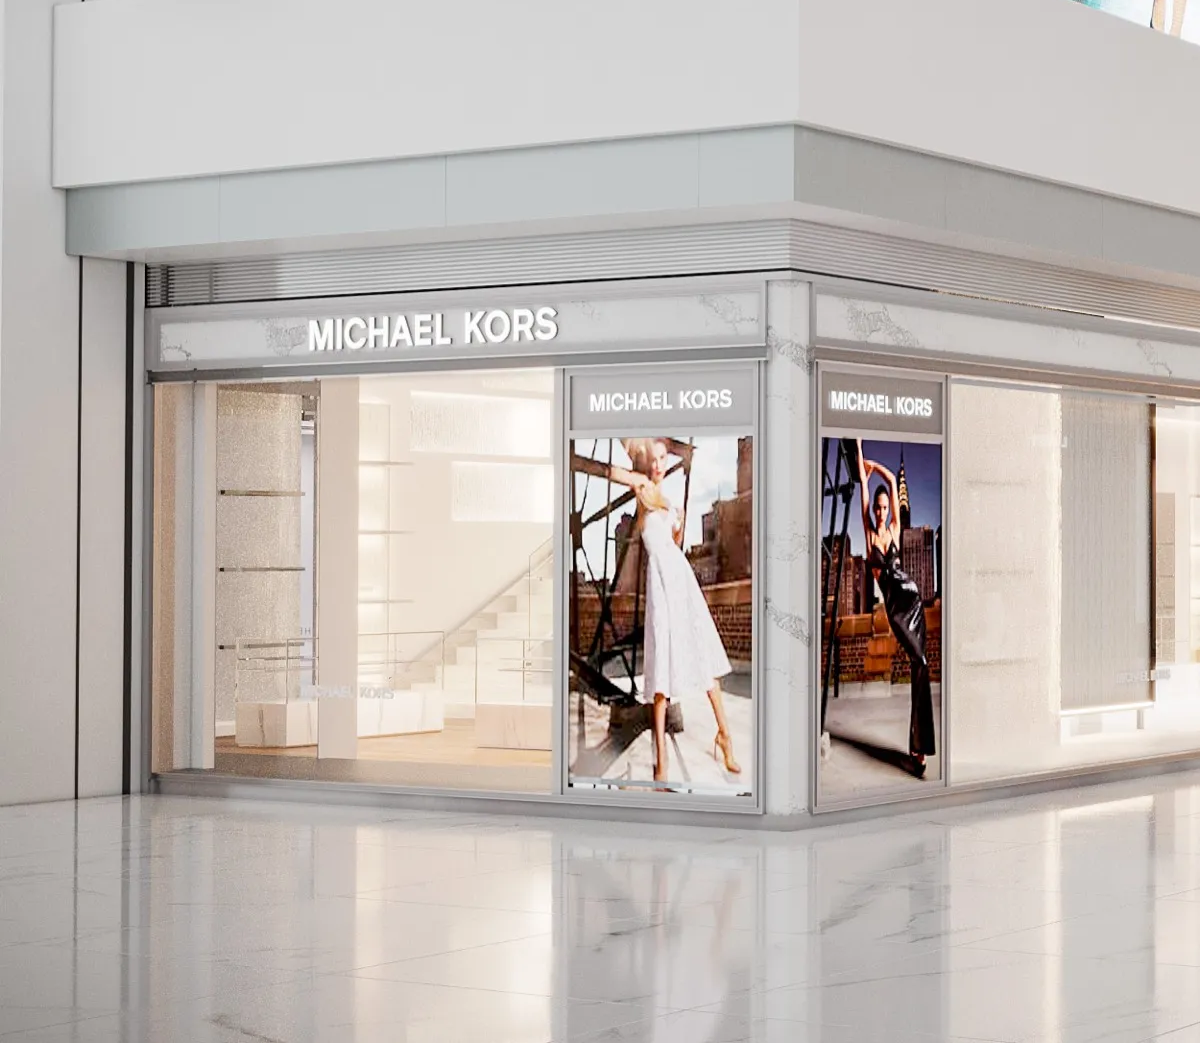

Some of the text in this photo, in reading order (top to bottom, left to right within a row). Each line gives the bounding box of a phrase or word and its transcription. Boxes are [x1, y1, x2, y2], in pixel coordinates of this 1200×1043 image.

[308, 306, 559, 352] MICHAEL KORS
[589, 388, 733, 412] MICHAEL KORS
[829, 390, 933, 417] MICHAEL KORS
